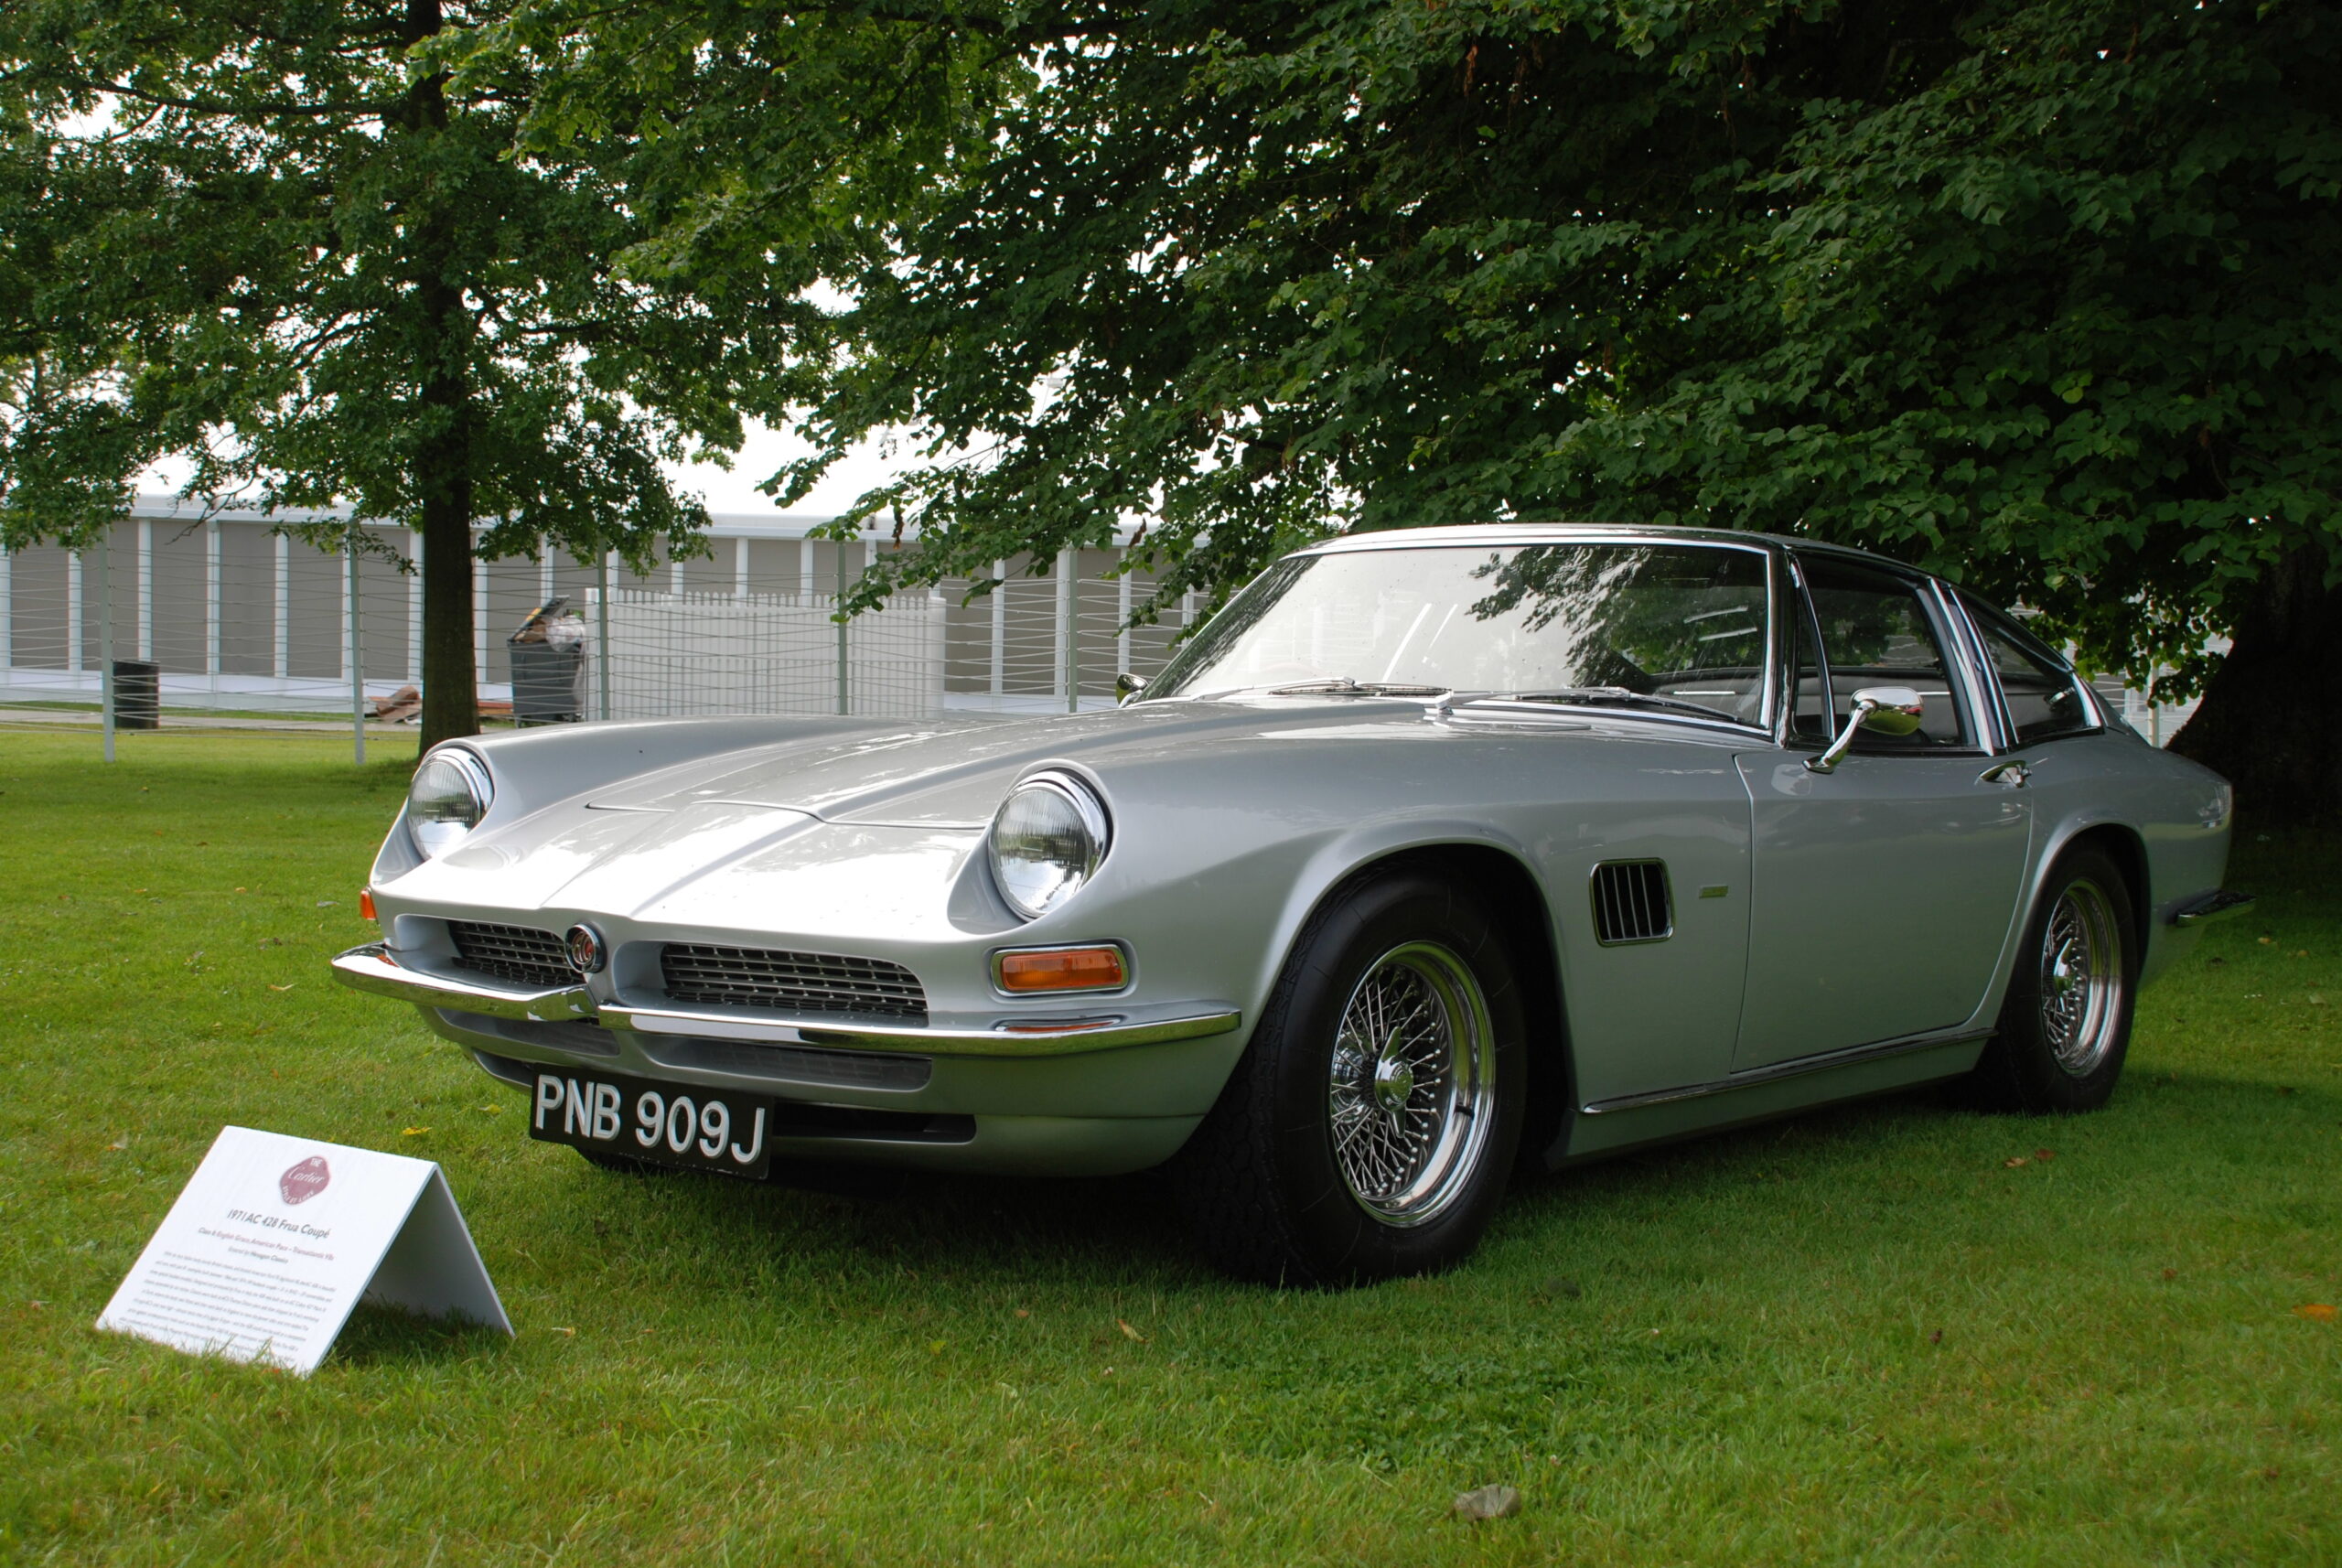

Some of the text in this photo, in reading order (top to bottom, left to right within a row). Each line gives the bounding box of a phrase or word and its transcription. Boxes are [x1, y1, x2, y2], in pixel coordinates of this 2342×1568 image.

[535, 1074, 766, 1165] PNB 909J
[288, 1166, 325, 1184] Cartier
[227, 1208, 331, 1240] 1971 AC 428 Frua Coupé
